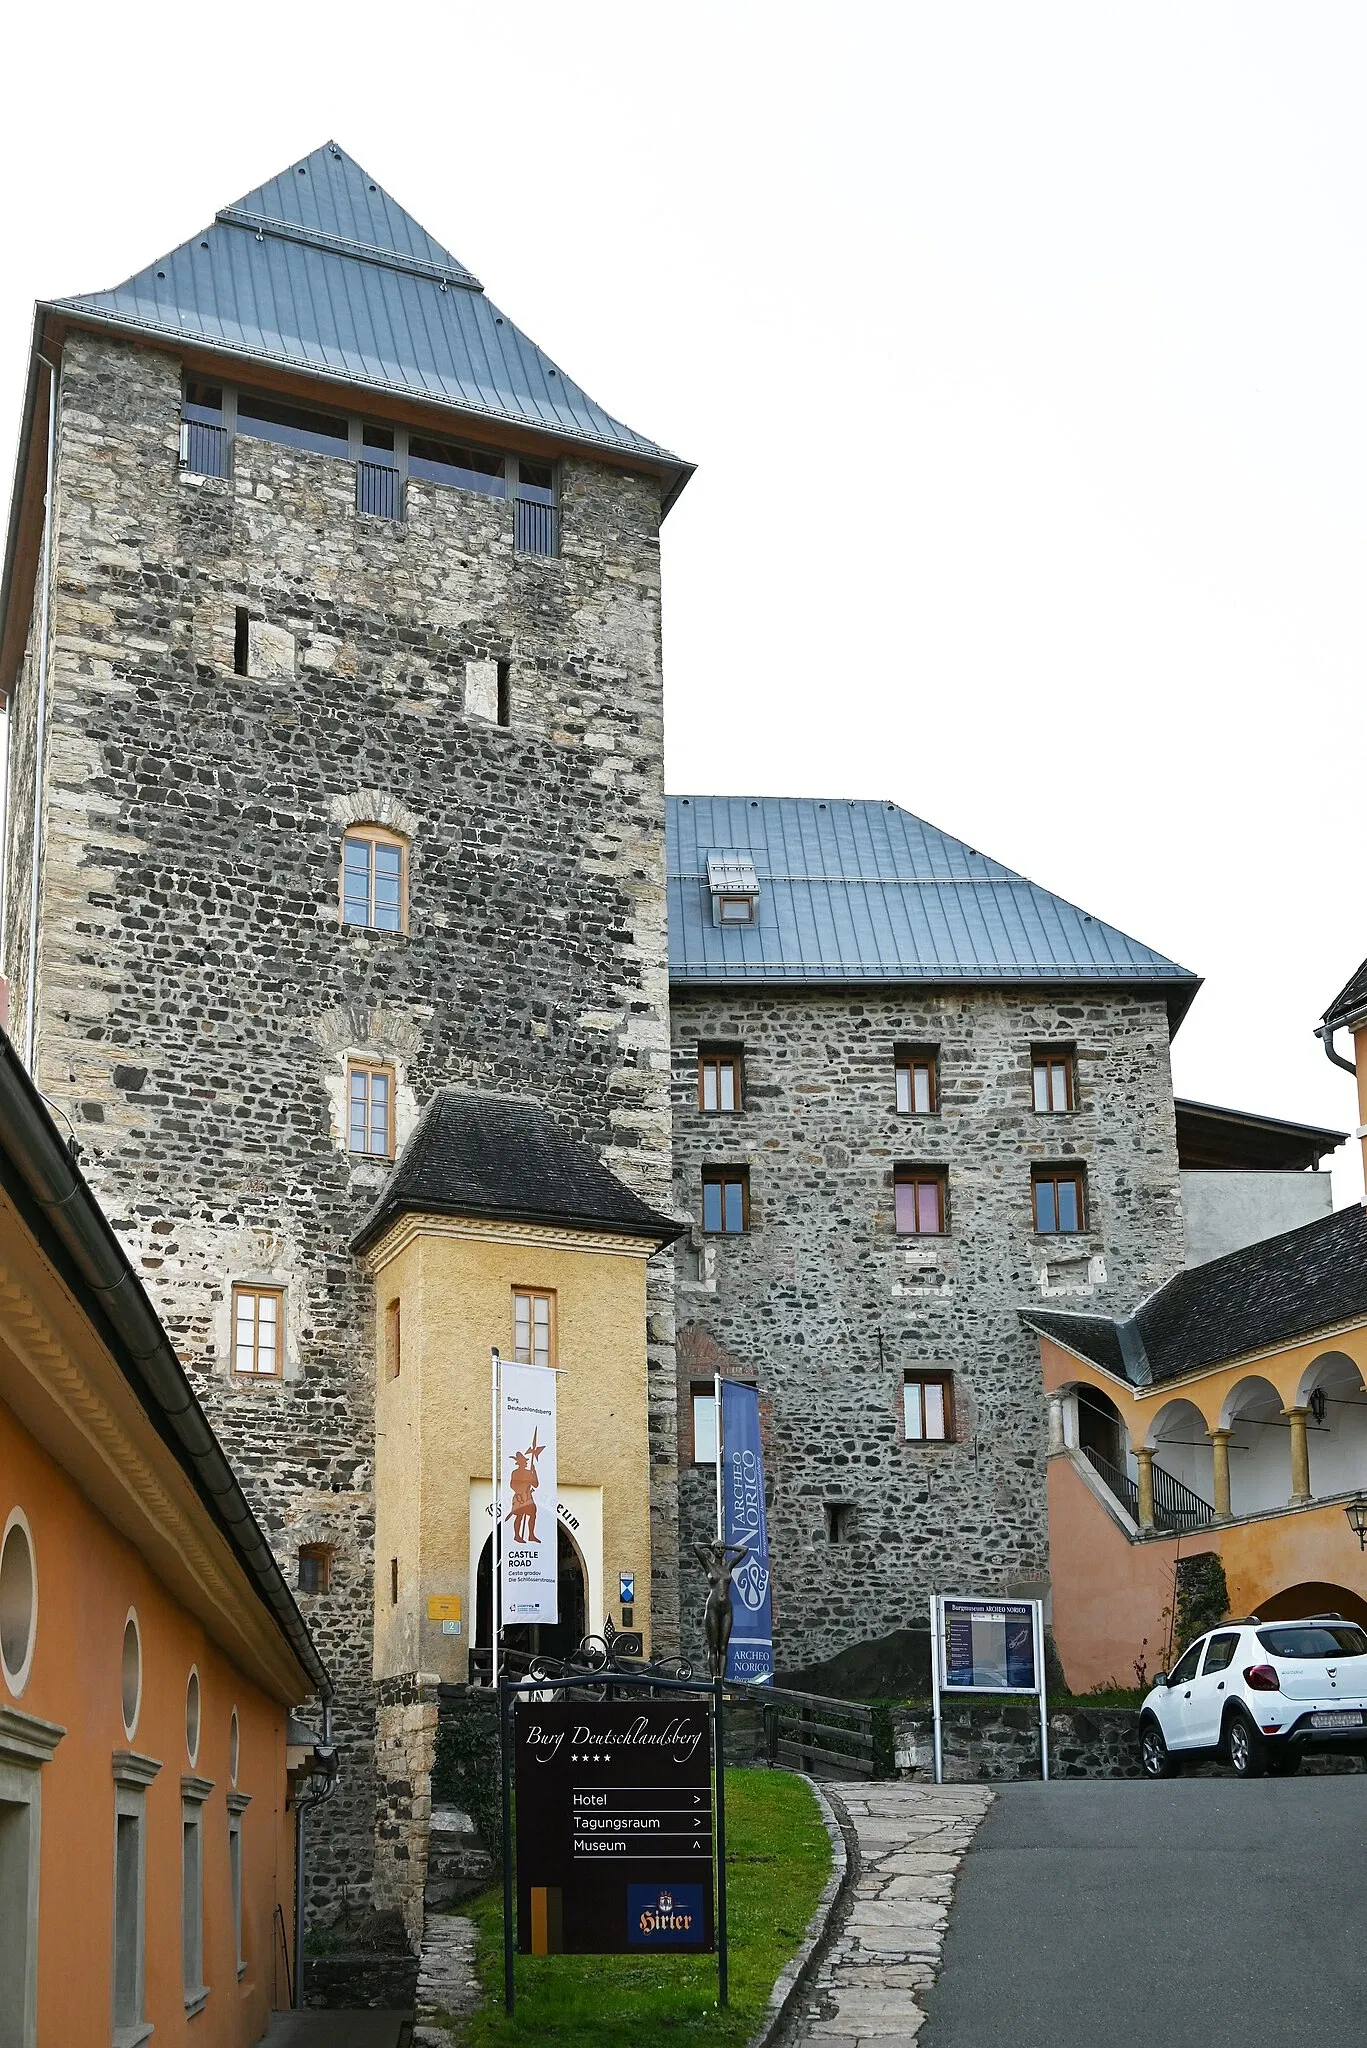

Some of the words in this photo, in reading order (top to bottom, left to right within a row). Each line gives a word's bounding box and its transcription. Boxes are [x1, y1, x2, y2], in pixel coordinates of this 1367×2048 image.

[507, 1405, 552, 1416] Deutschlandsberg
[732, 1452, 746, 1524] ARCHEO
[732, 1449, 760, 1555] NORICO
[508, 1551, 539, 1559] CASTLE
[951, 1604, 985, 1612] Burgmuseum
[985, 1605, 1006, 1613] ARCHEO
[1006, 1606, 1026, 1614] NORICO
[449, 1622, 455, 1630] 2
[733, 1651, 770, 1661] ARCHEO
[734, 1662, 770, 1672] NORICO
[526, 1726, 565, 1763] Burg
[571, 1716, 702, 1763] Deutschlandsberg
[573, 1794, 607, 1805] Hotel
[573, 1817, 660, 1831] Tagungsraum
[574, 1839, 626, 1851] Museum
[639, 1910, 692, 1936] Hirter
